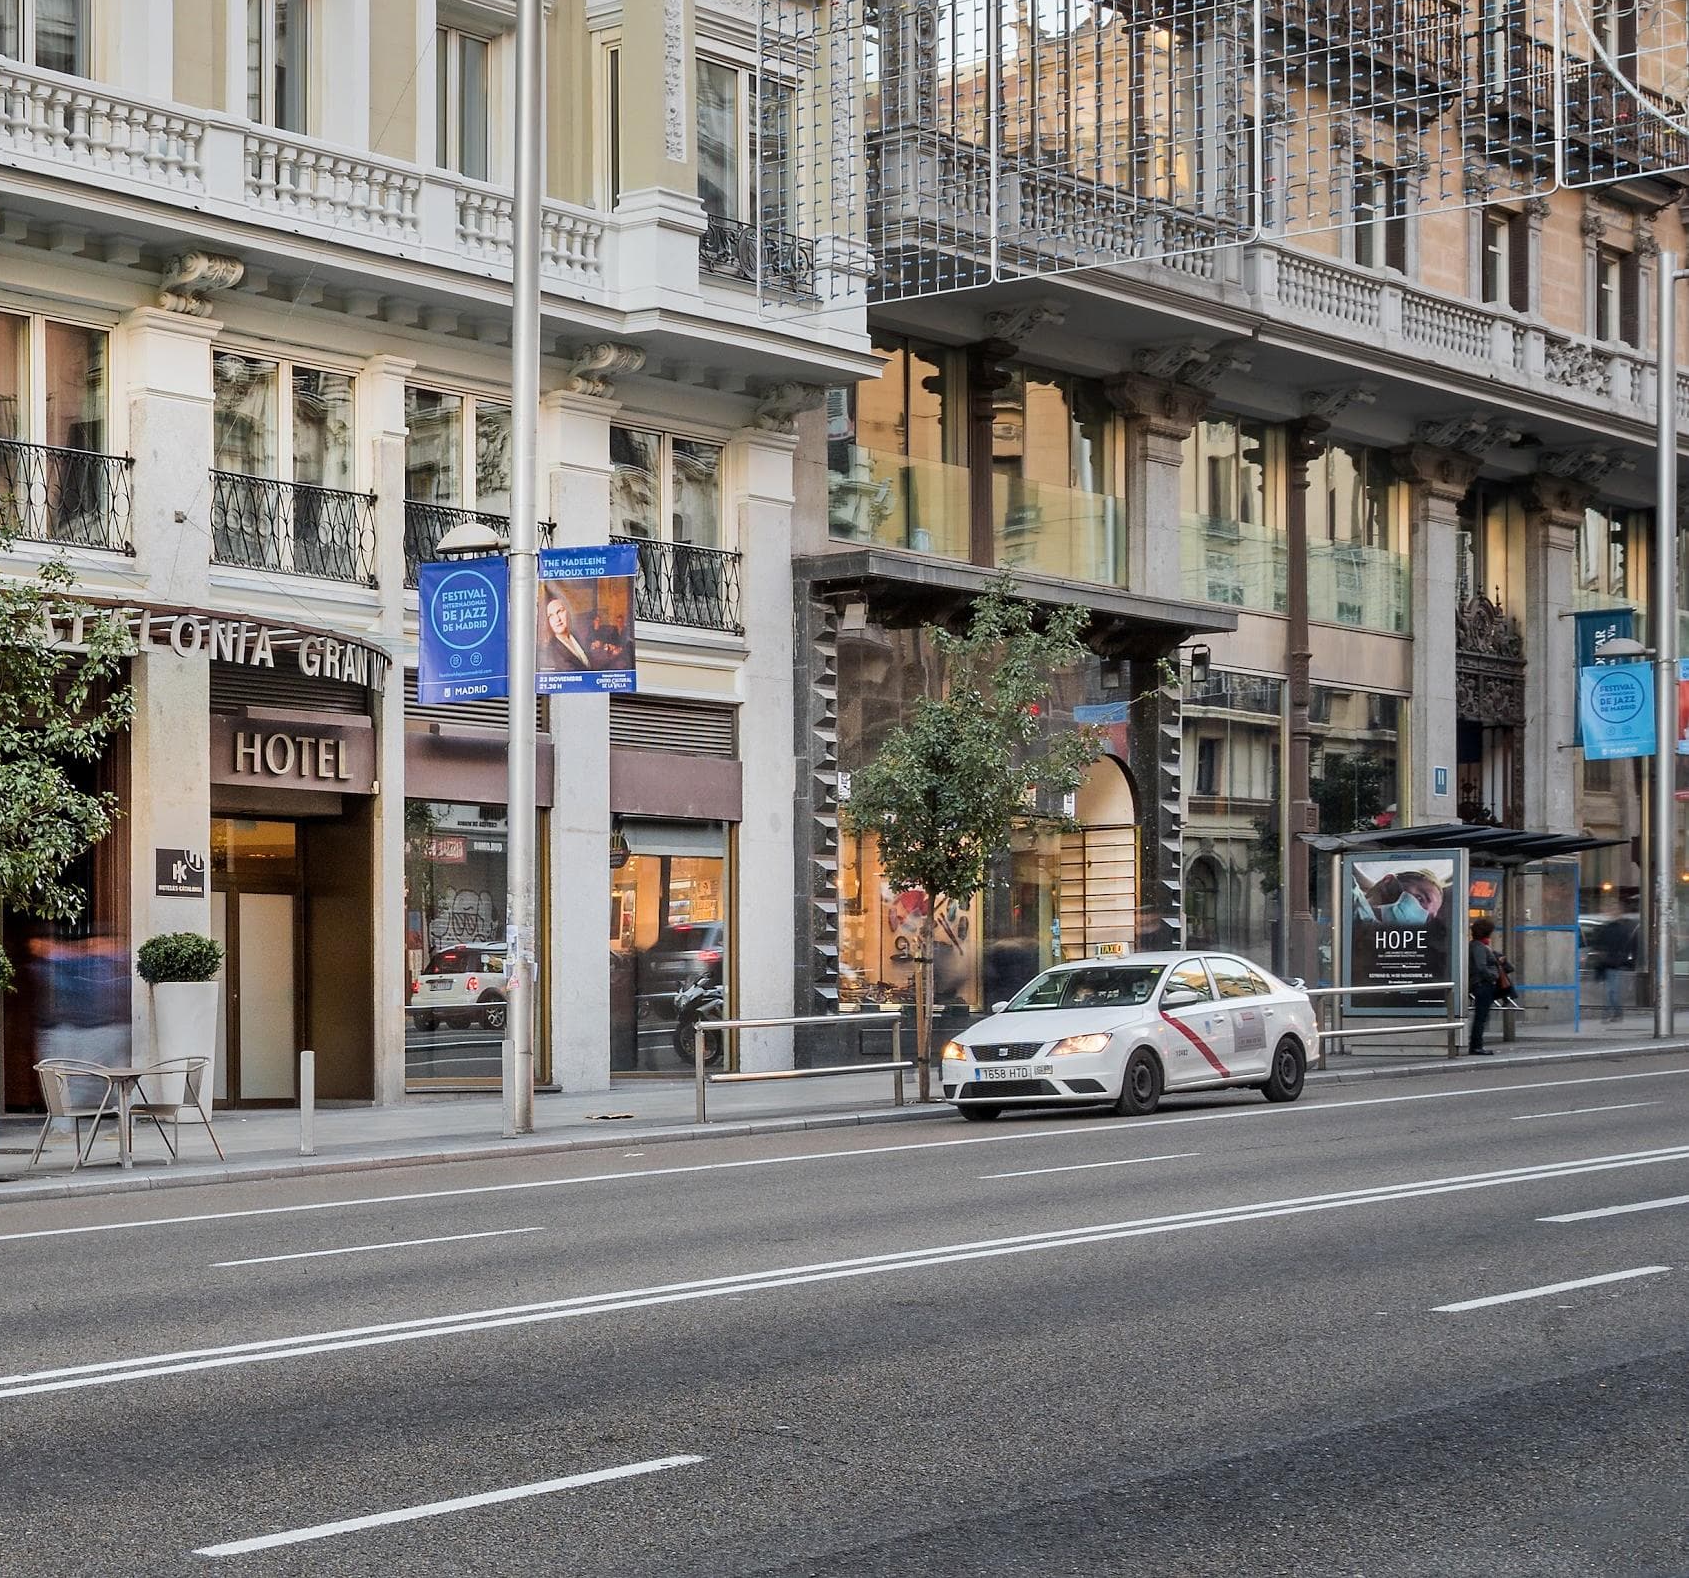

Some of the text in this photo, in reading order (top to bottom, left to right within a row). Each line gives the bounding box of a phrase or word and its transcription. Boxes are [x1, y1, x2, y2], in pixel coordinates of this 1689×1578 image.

[543, 556, 607, 568] THE MADELEINE
[543, 567, 605, 578] PEYROUX TRIO
[442, 588, 487, 603] FESTIVAL
[442, 606, 487, 623] DE JAZZ
[442, 619, 488, 633] DE MADRID
[8, 597, 275, 669] TALONIA
[298, 634, 368, 687] GRAN
[454, 684, 488, 696] MADRID
[1599, 683, 1635, 693] FESTIVAL
[1600, 695, 1636, 706] DE JAZZ
[236, 731, 354, 781] HOTEL
[1375, 930, 1428, 950] HOPE
[983, 1067, 1028, 1079] 1658 HTD
